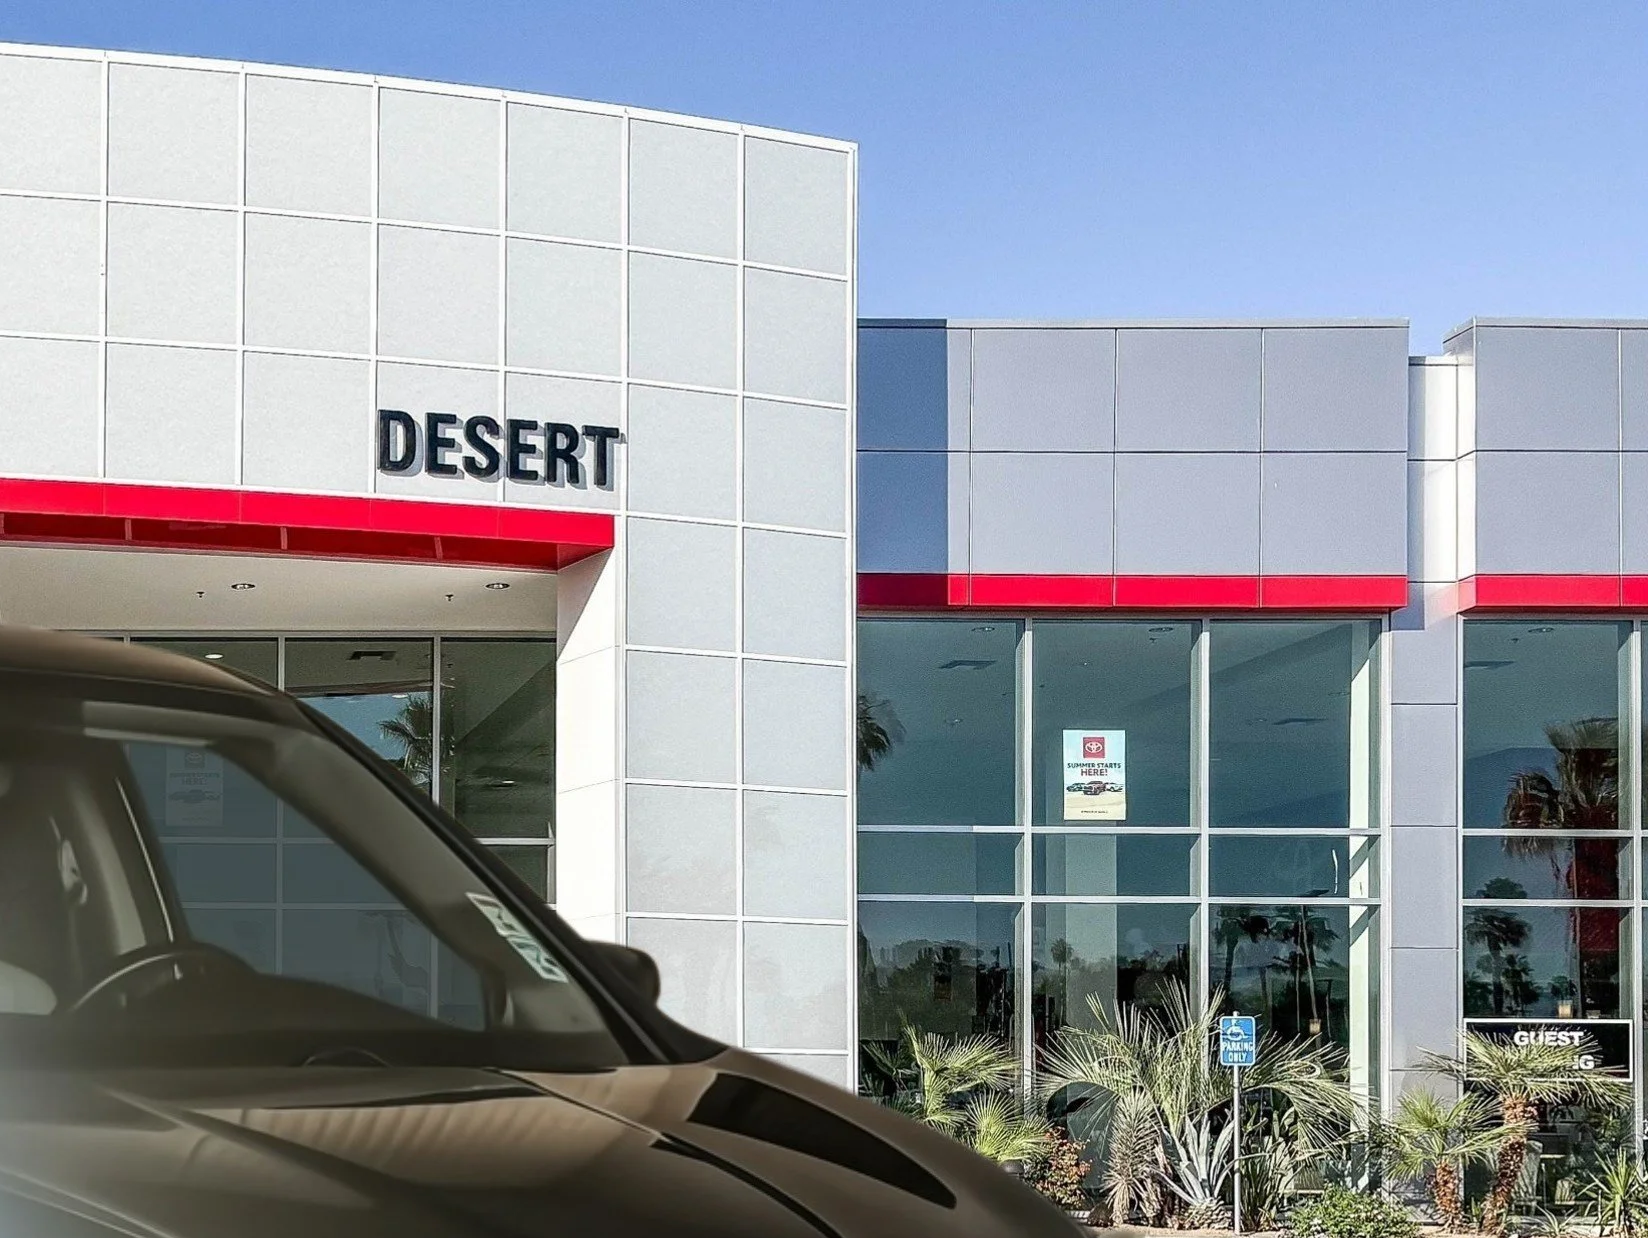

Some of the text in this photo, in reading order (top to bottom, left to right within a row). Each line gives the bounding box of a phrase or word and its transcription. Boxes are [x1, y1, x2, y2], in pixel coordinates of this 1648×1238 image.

[377, 409, 620, 486] DESERT
[1080, 768, 1108, 776] HERE!
[1513, 1030, 1585, 1046] GUEST
[1222, 1041, 1254, 1051] PARKING
[1228, 1052, 1248, 1062] ONLY
